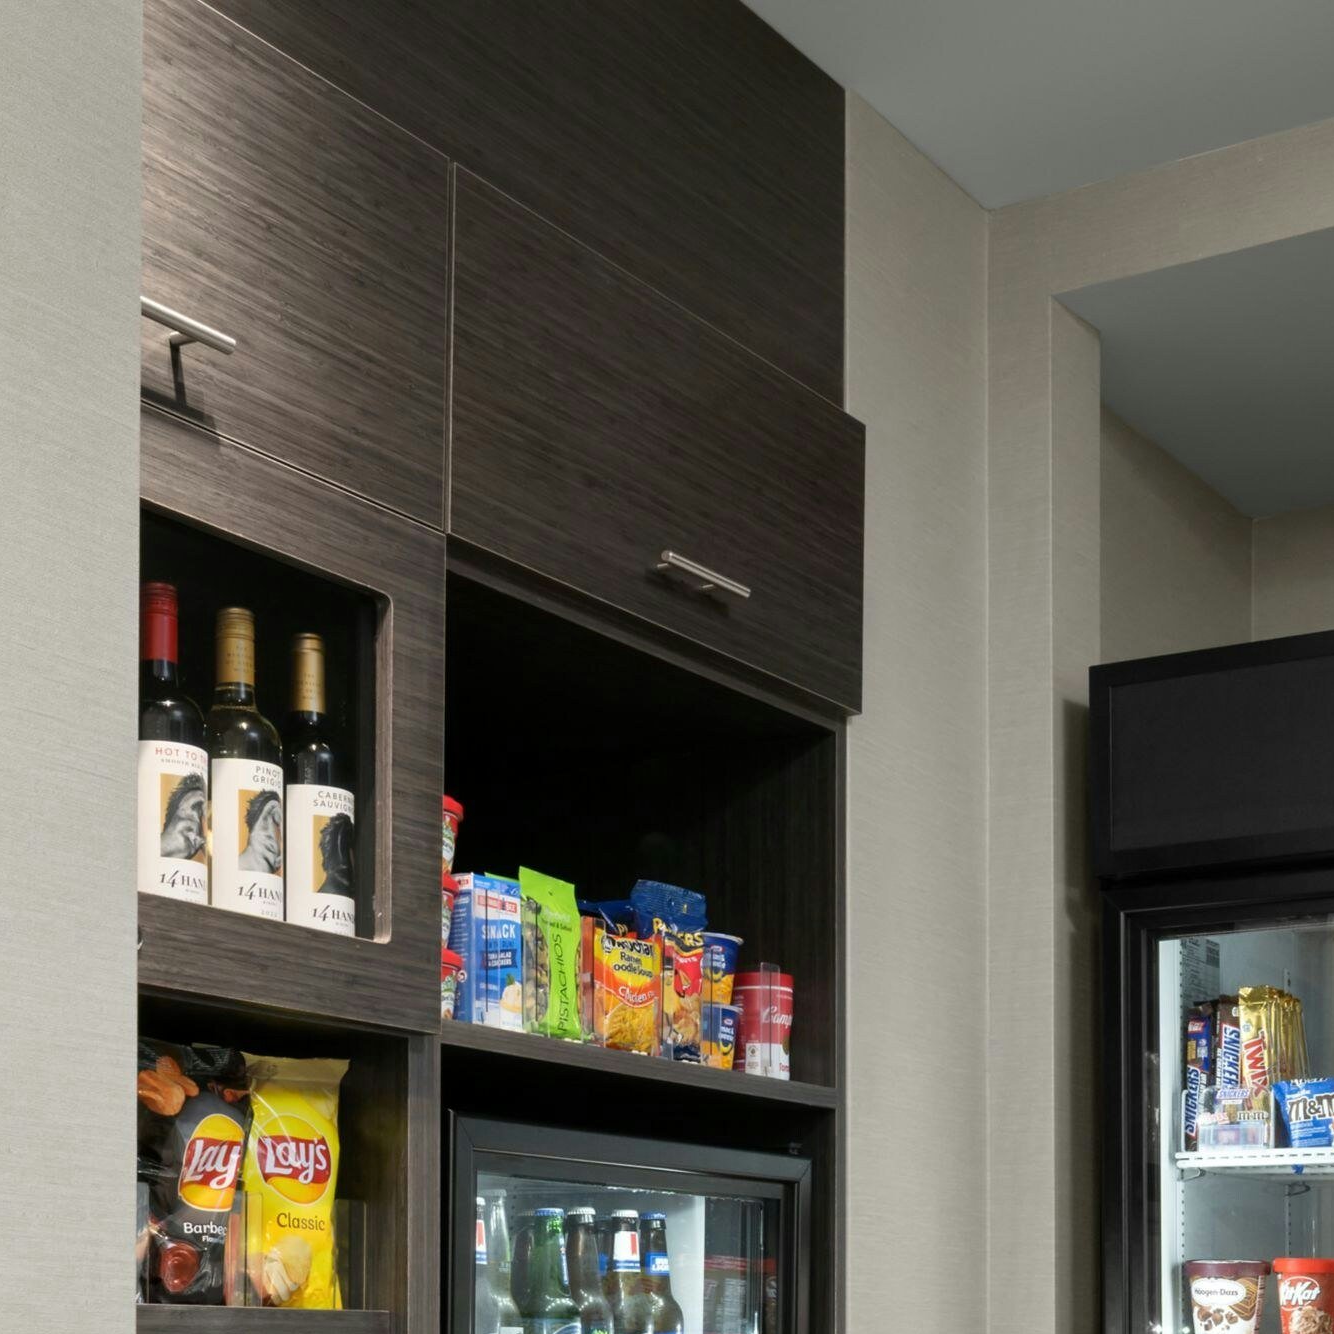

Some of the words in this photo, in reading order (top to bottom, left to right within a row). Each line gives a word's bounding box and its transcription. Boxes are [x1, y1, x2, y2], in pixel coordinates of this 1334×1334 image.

[155, 746, 180, 757] HOT
[184, 750, 198, 761] TO
[160, 870, 180, 889] 14
[238, 882, 257, 901] 14
[311, 904, 330, 922] 14
[551, 933, 568, 1032] PISTACHIOS
[1242, 1028, 1269, 1097] TWIX
[1184, 1065, 1201, 1136] SNICKERS
[263, 1136, 327, 1185] Lay's
[275, 1212, 326, 1232] Classic
